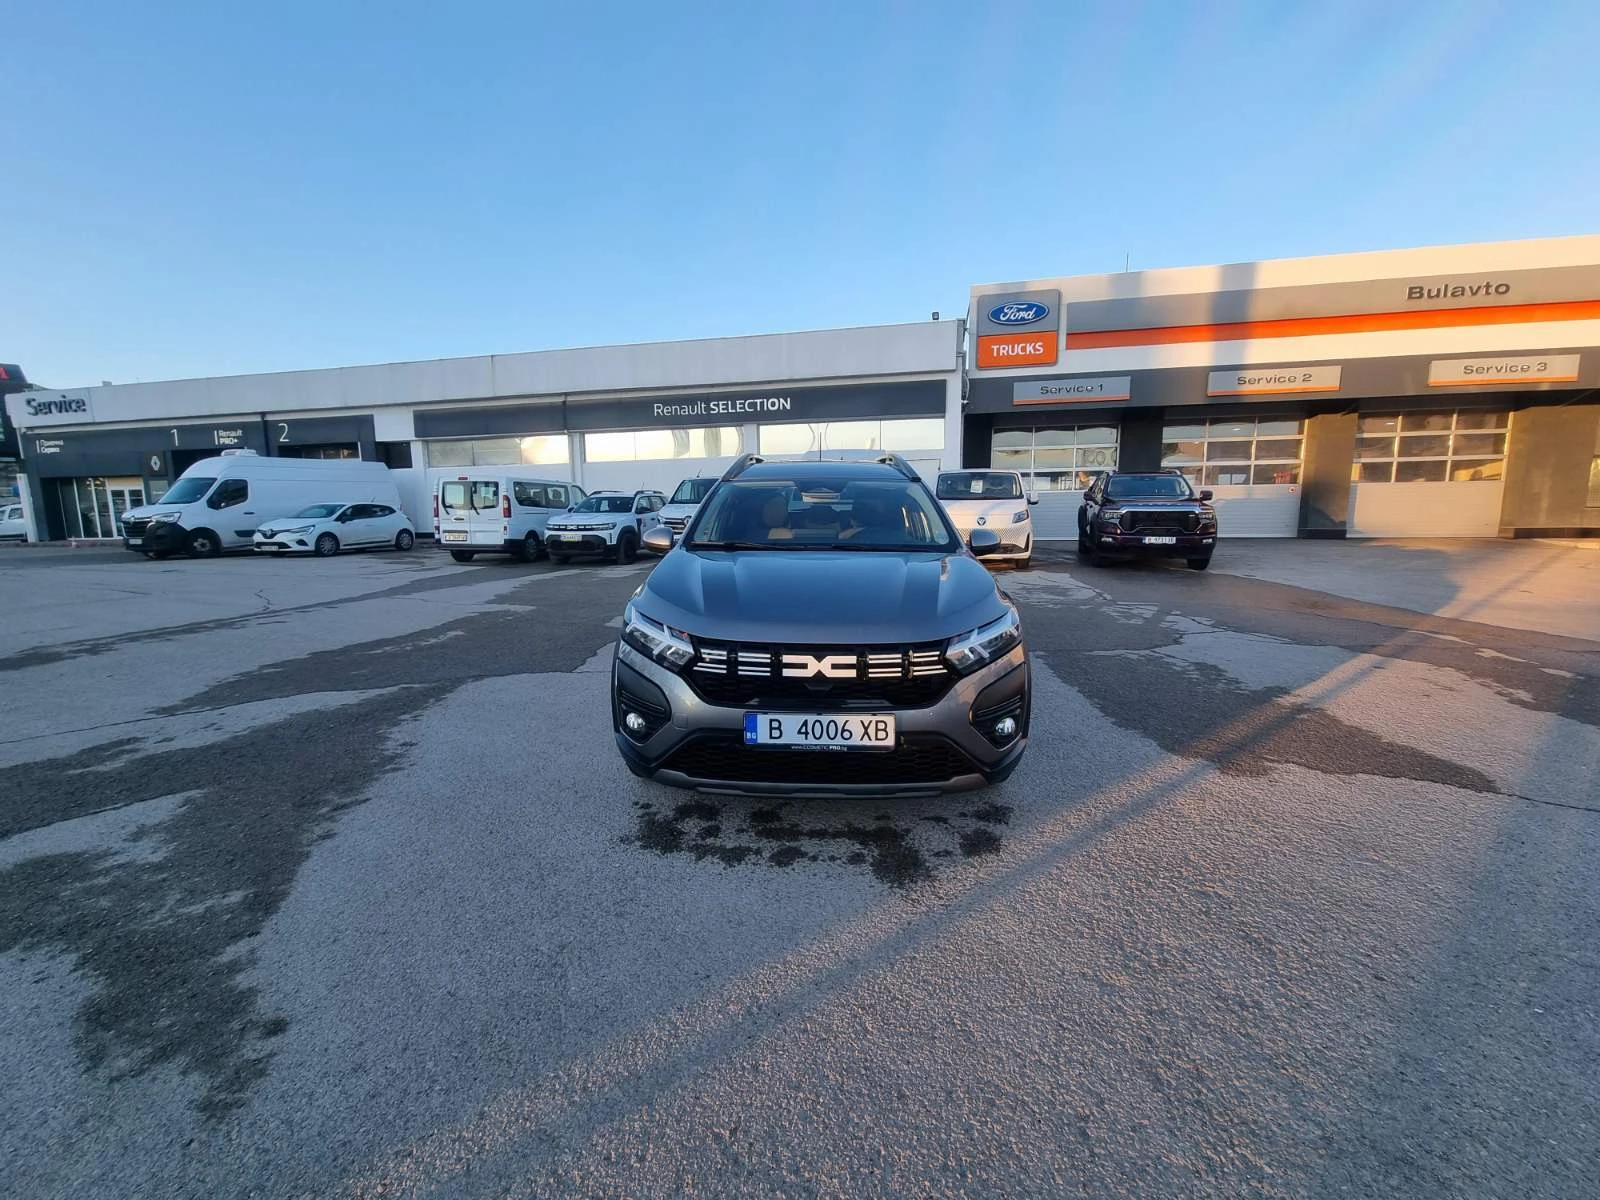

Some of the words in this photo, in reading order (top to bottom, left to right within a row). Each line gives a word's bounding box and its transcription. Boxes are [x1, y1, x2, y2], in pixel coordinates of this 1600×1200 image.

[1406, 281, 1511, 300] Bulavto
[999, 304, 1037, 321] Ford
[991, 342, 1044, 357] TRUCKS
[1463, 363, 1531, 375] Service
[1536, 361, 1548, 372] 3
[1237, 374, 1297, 385] Service
[1302, 373, 1313, 382] 2
[1040, 384, 1094, 395] Service
[1098, 383, 1104, 392] 1
[25, 394, 87, 416] Service
[653, 401, 707, 417] Renault
[709, 397, 791, 414] SELECTION
[170, 428, 179, 447] 1
[278, 423, 290, 442] 2
[768, 718, 783, 740] B
[796, 718, 853, 741] 4006
[859, 719, 889, 742] XB
